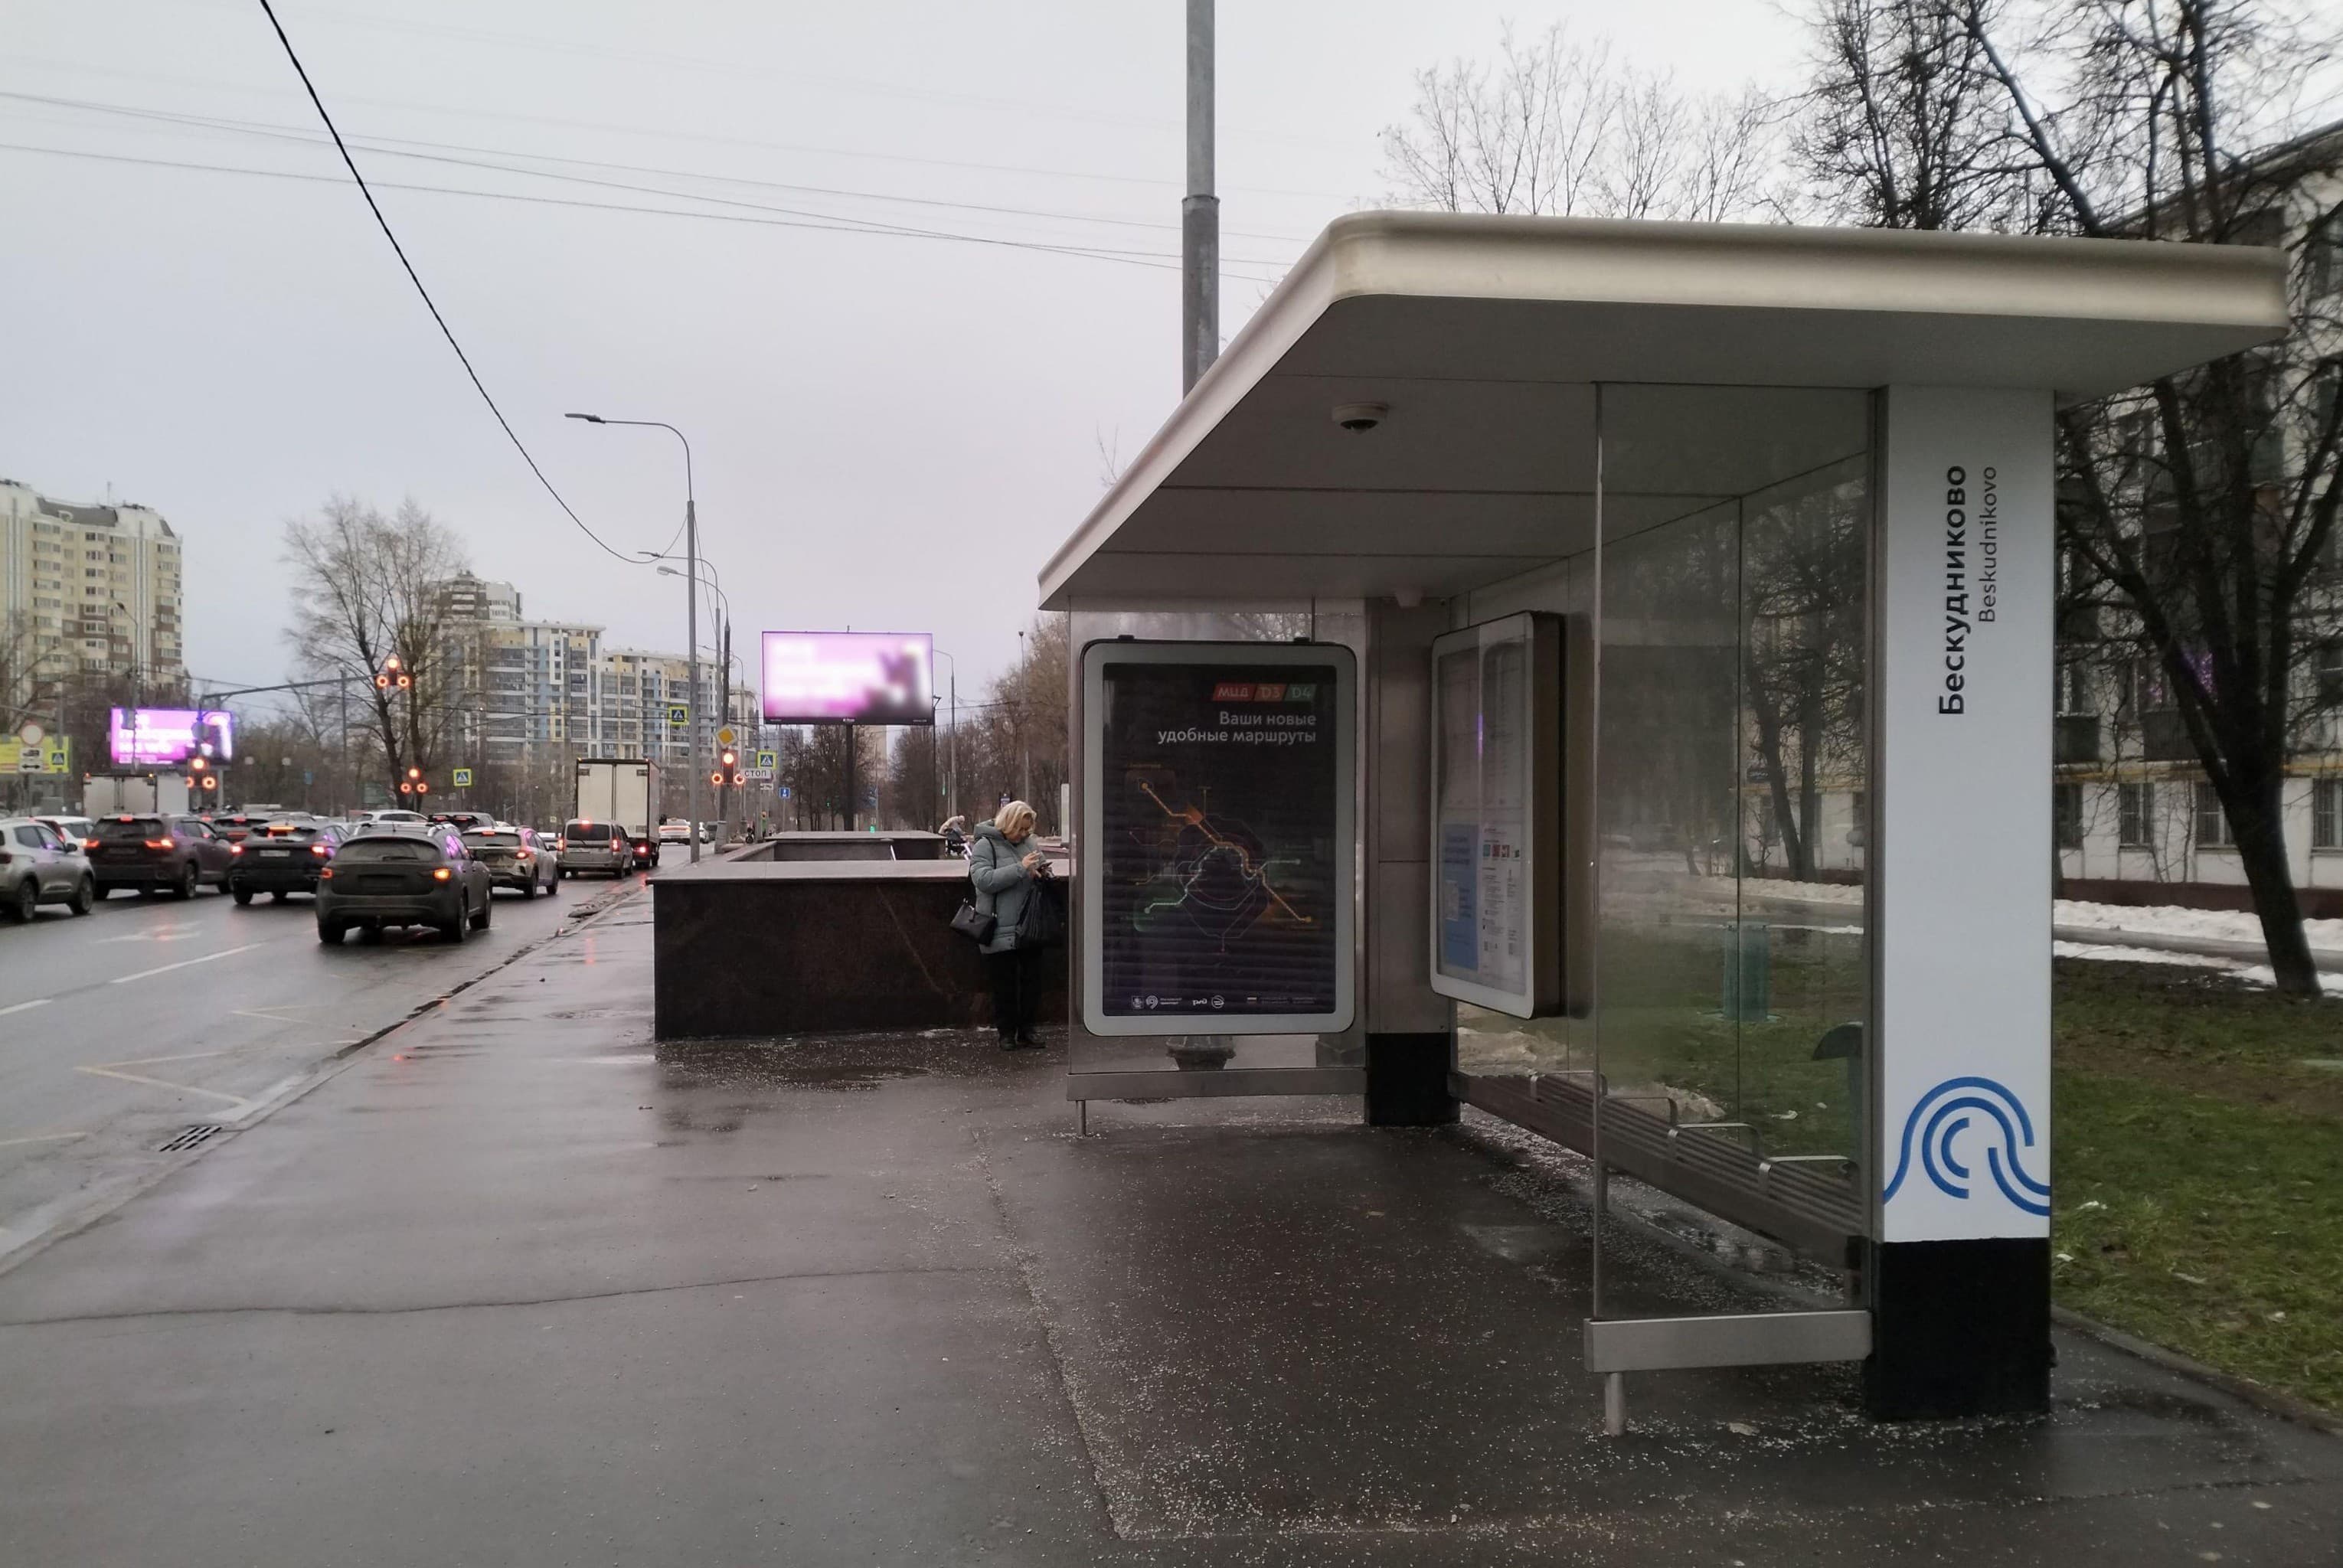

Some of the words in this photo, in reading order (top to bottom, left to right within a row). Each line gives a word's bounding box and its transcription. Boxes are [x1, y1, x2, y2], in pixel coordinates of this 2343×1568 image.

[1979, 466, 1997, 622] Beskudnikovo
[1939, 466, 1971, 714] Бескудниково
[1217, 688, 1249, 697] МЦД
[1261, 688, 1281, 698] D3
[1292, 688, 1312, 698] D4
[1220, 711, 1262, 725] Ваши
[1266, 714, 1316, 726] новые
[1158, 727, 1228, 745] удобные
[1232, 730, 1316, 746] маршруты
